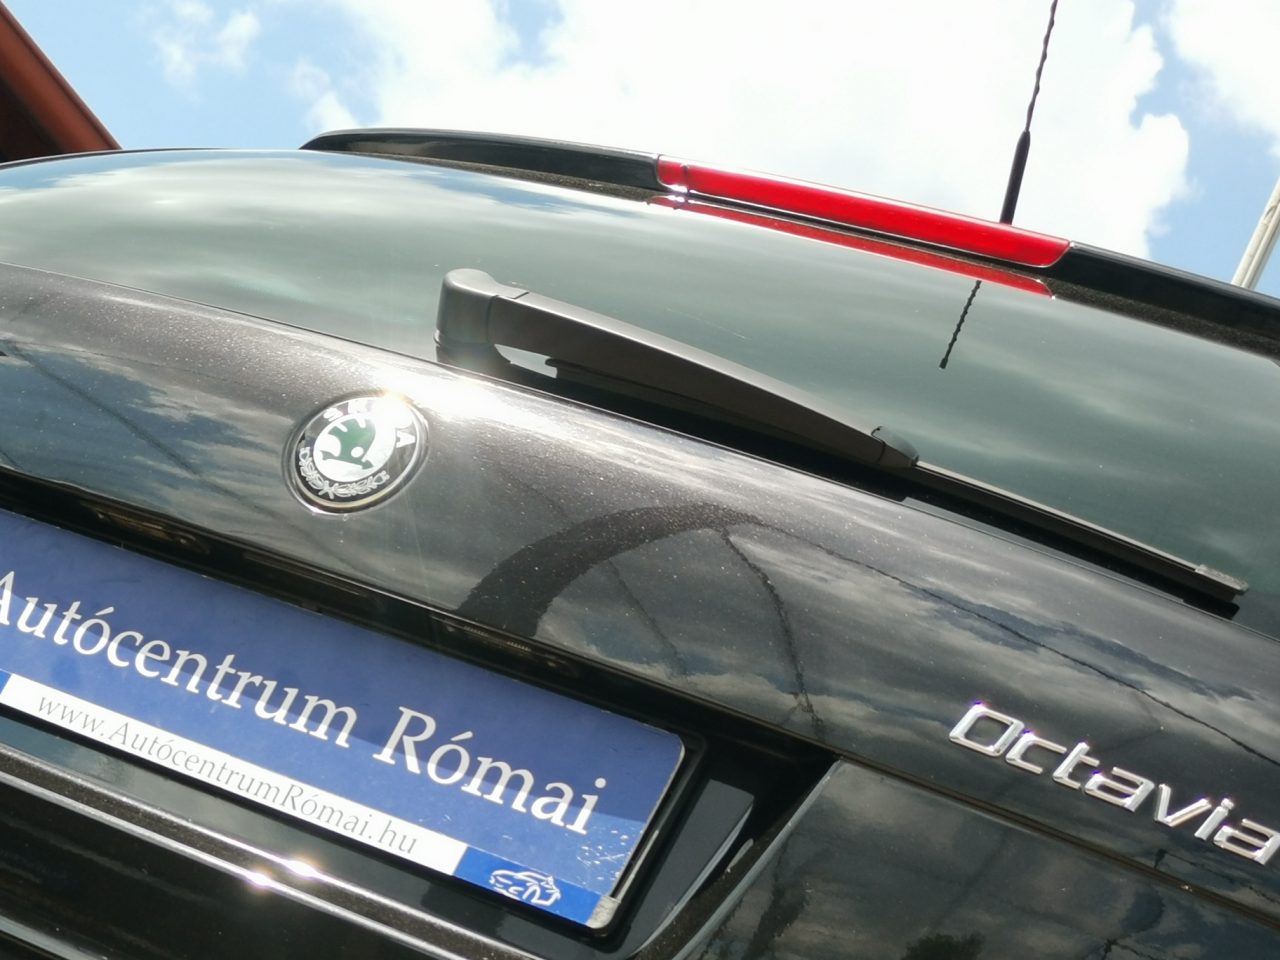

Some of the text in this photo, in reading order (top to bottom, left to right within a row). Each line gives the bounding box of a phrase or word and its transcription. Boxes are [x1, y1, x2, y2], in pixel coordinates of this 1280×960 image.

[37, 696, 417, 855] www.AutócentrumRómai.hu
[372, 706, 607, 836] Római
[949, 702, 1280, 866] Octavia
